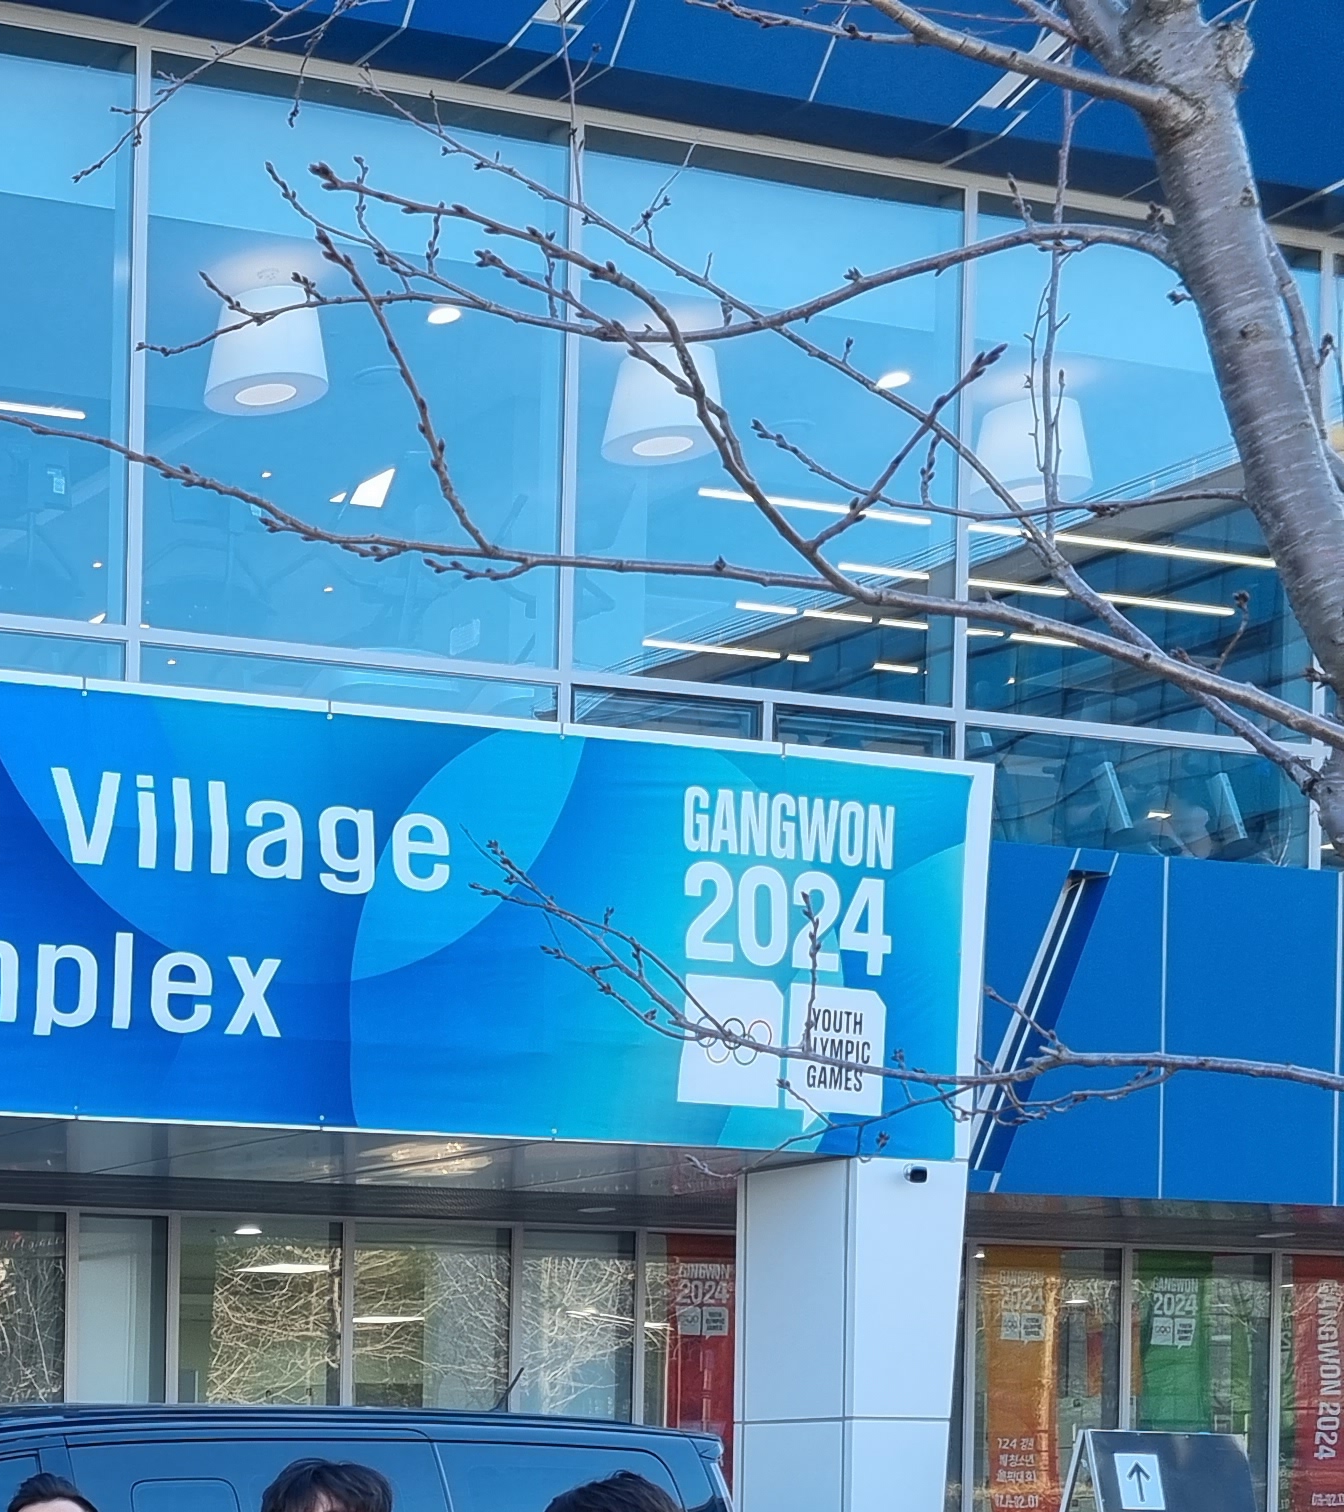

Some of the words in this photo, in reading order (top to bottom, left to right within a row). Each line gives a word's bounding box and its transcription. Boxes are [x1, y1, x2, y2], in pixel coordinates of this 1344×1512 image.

[51, 767, 451, 896] Village
[684, 786, 896, 870] GANGWON
[685, 860, 892, 976] 2024
[811, 1007, 864, 1035] YOUTH
[806, 1064, 863, 1092] GAMES
[1153, 1292, 1199, 1316] 2024
[1313, 1401, 1341, 1460] 2024
